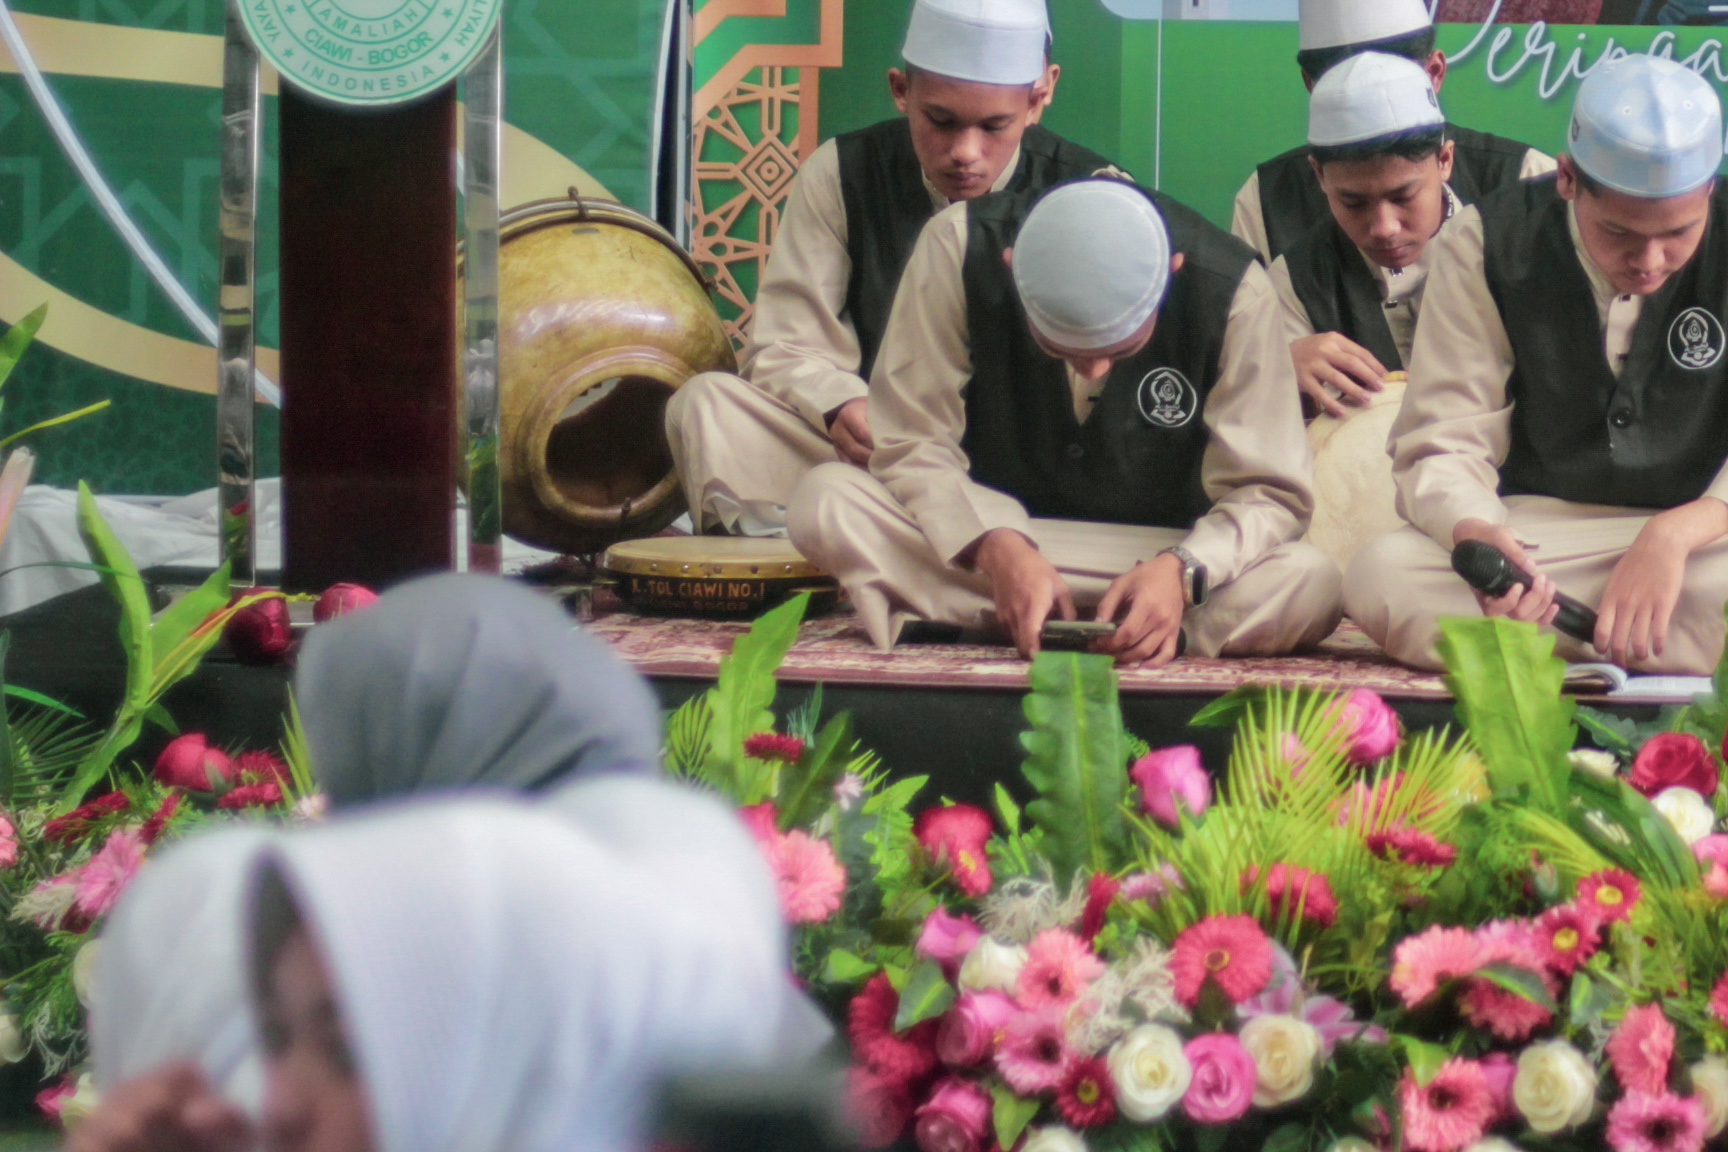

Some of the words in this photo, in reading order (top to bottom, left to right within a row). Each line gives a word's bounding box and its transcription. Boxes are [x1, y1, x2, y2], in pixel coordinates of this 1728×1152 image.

[319, 7, 419, 38] AMALIAH
[304, 28, 352, 63] CIAWI
[368, 30, 434, 65] BOGOR
[301, 61, 435, 92] INDONESIA
[679, 582, 723, 597] CIAWI
